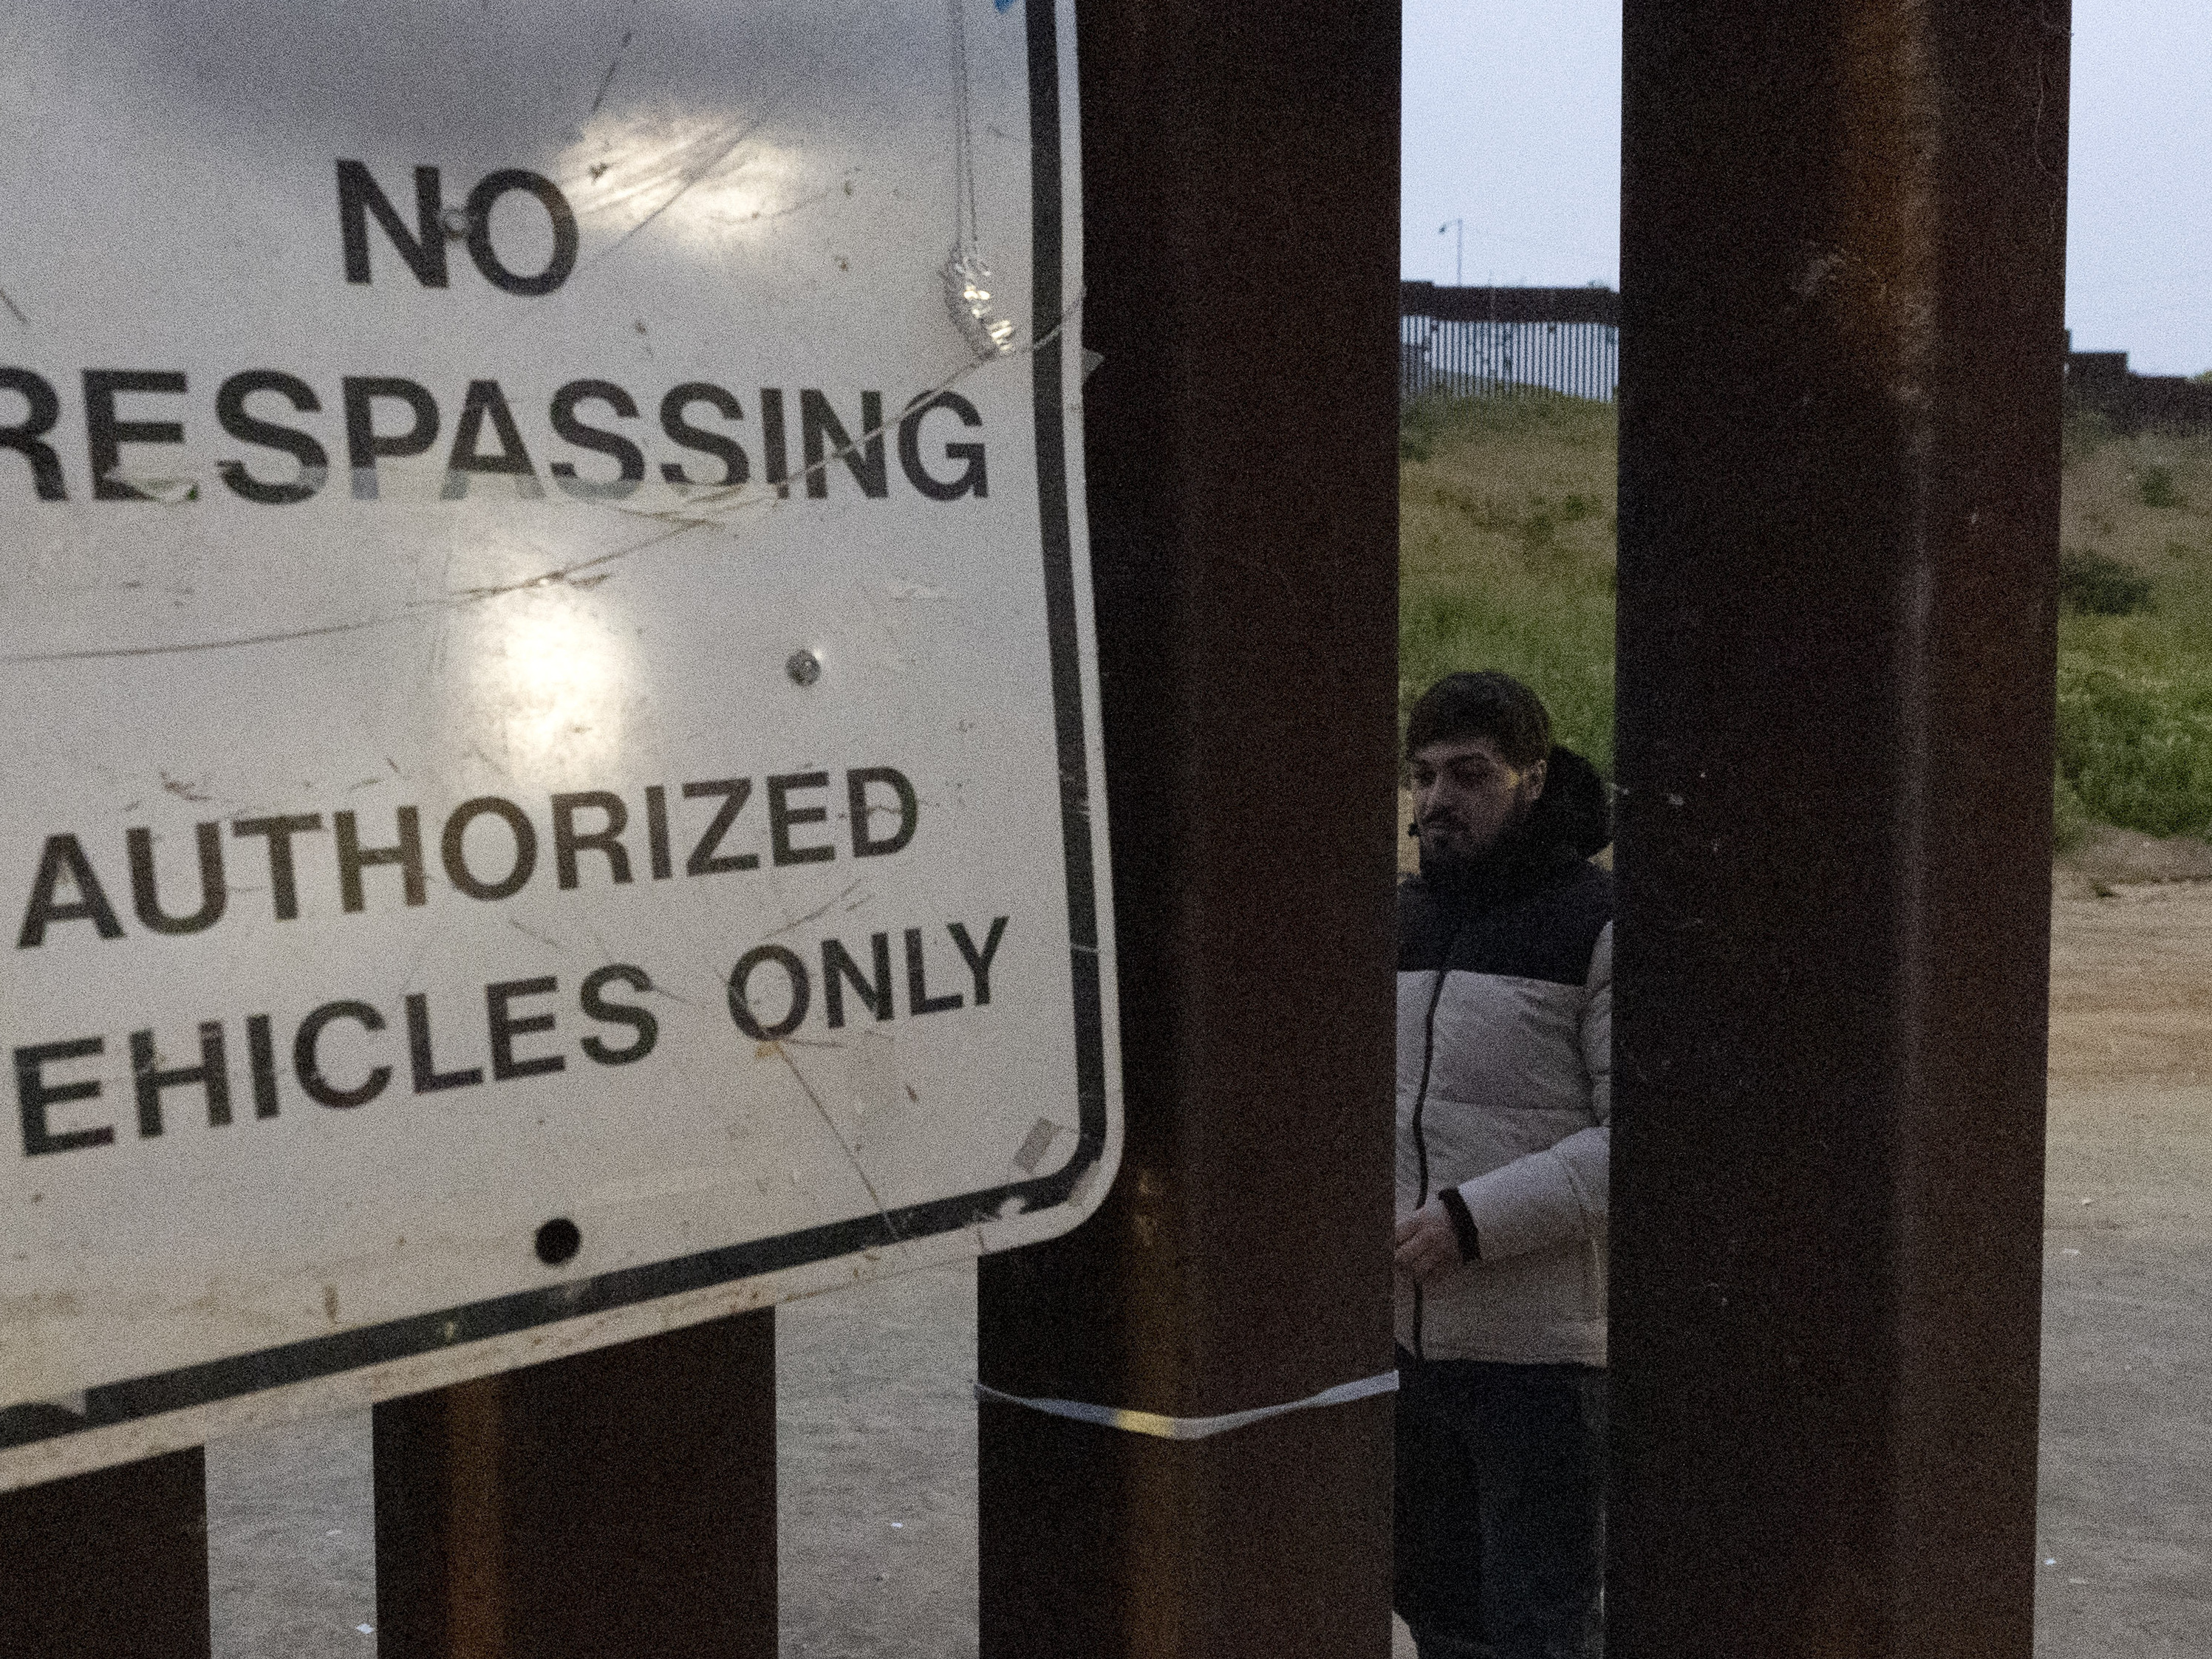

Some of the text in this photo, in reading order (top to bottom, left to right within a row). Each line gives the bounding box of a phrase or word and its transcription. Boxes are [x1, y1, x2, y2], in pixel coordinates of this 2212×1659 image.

[335, 158, 580, 297] NO
[0, 368, 989, 505] RESPASSING
[16, 766, 919, 949] AUTHORIZED
[13, 916, 1009, 1157] EHICLES ONLY
